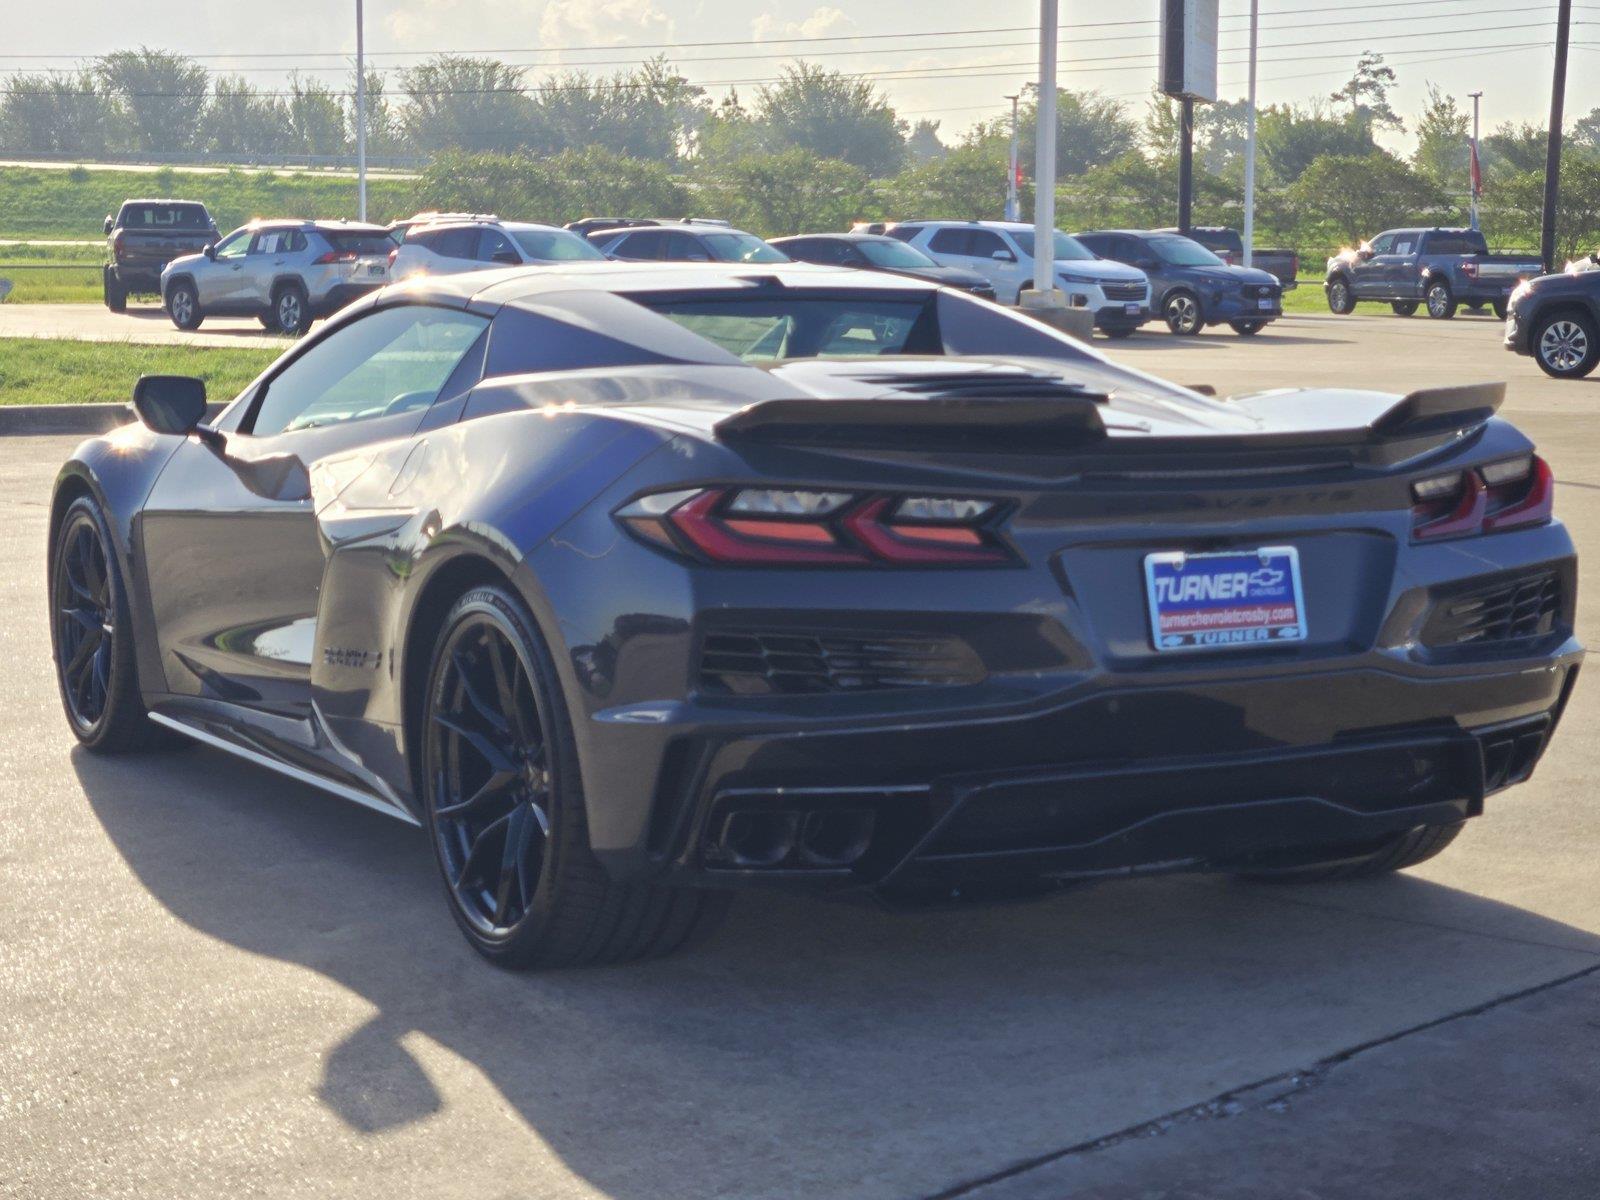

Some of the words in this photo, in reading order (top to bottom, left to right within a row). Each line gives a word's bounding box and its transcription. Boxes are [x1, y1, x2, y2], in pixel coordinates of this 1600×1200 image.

[1155, 572, 1249, 603] TURNER
[1160, 607, 1294, 627] turnerchevroletcrosby.com
[1193, 628, 1269, 644] TURNER
